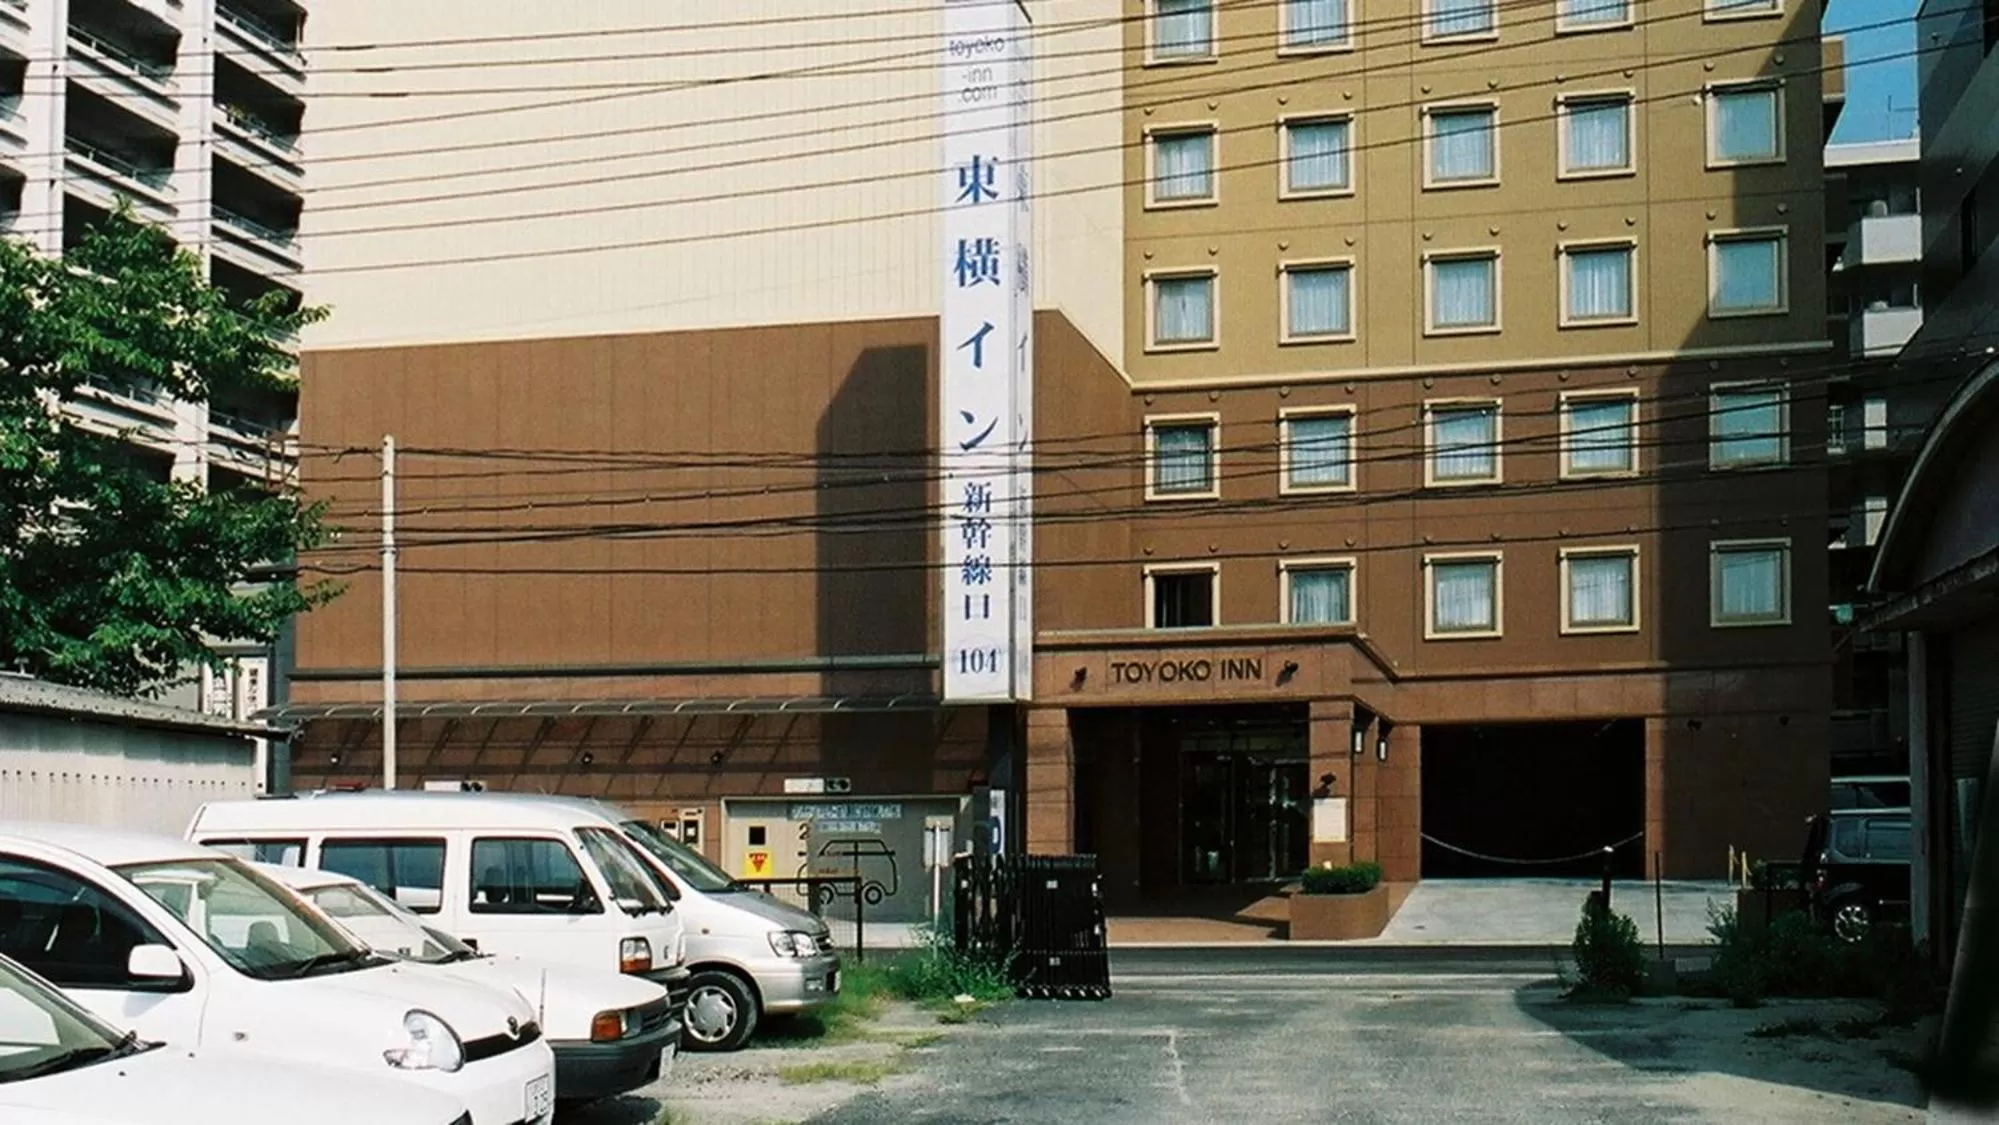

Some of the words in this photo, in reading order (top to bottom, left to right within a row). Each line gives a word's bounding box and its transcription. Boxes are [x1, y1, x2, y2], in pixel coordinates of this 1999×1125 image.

[949, 36, 1004, 59] toyoko
[1111, 659, 1212, 683] TOYOKO
[1220, 658, 1263, 680] INN
